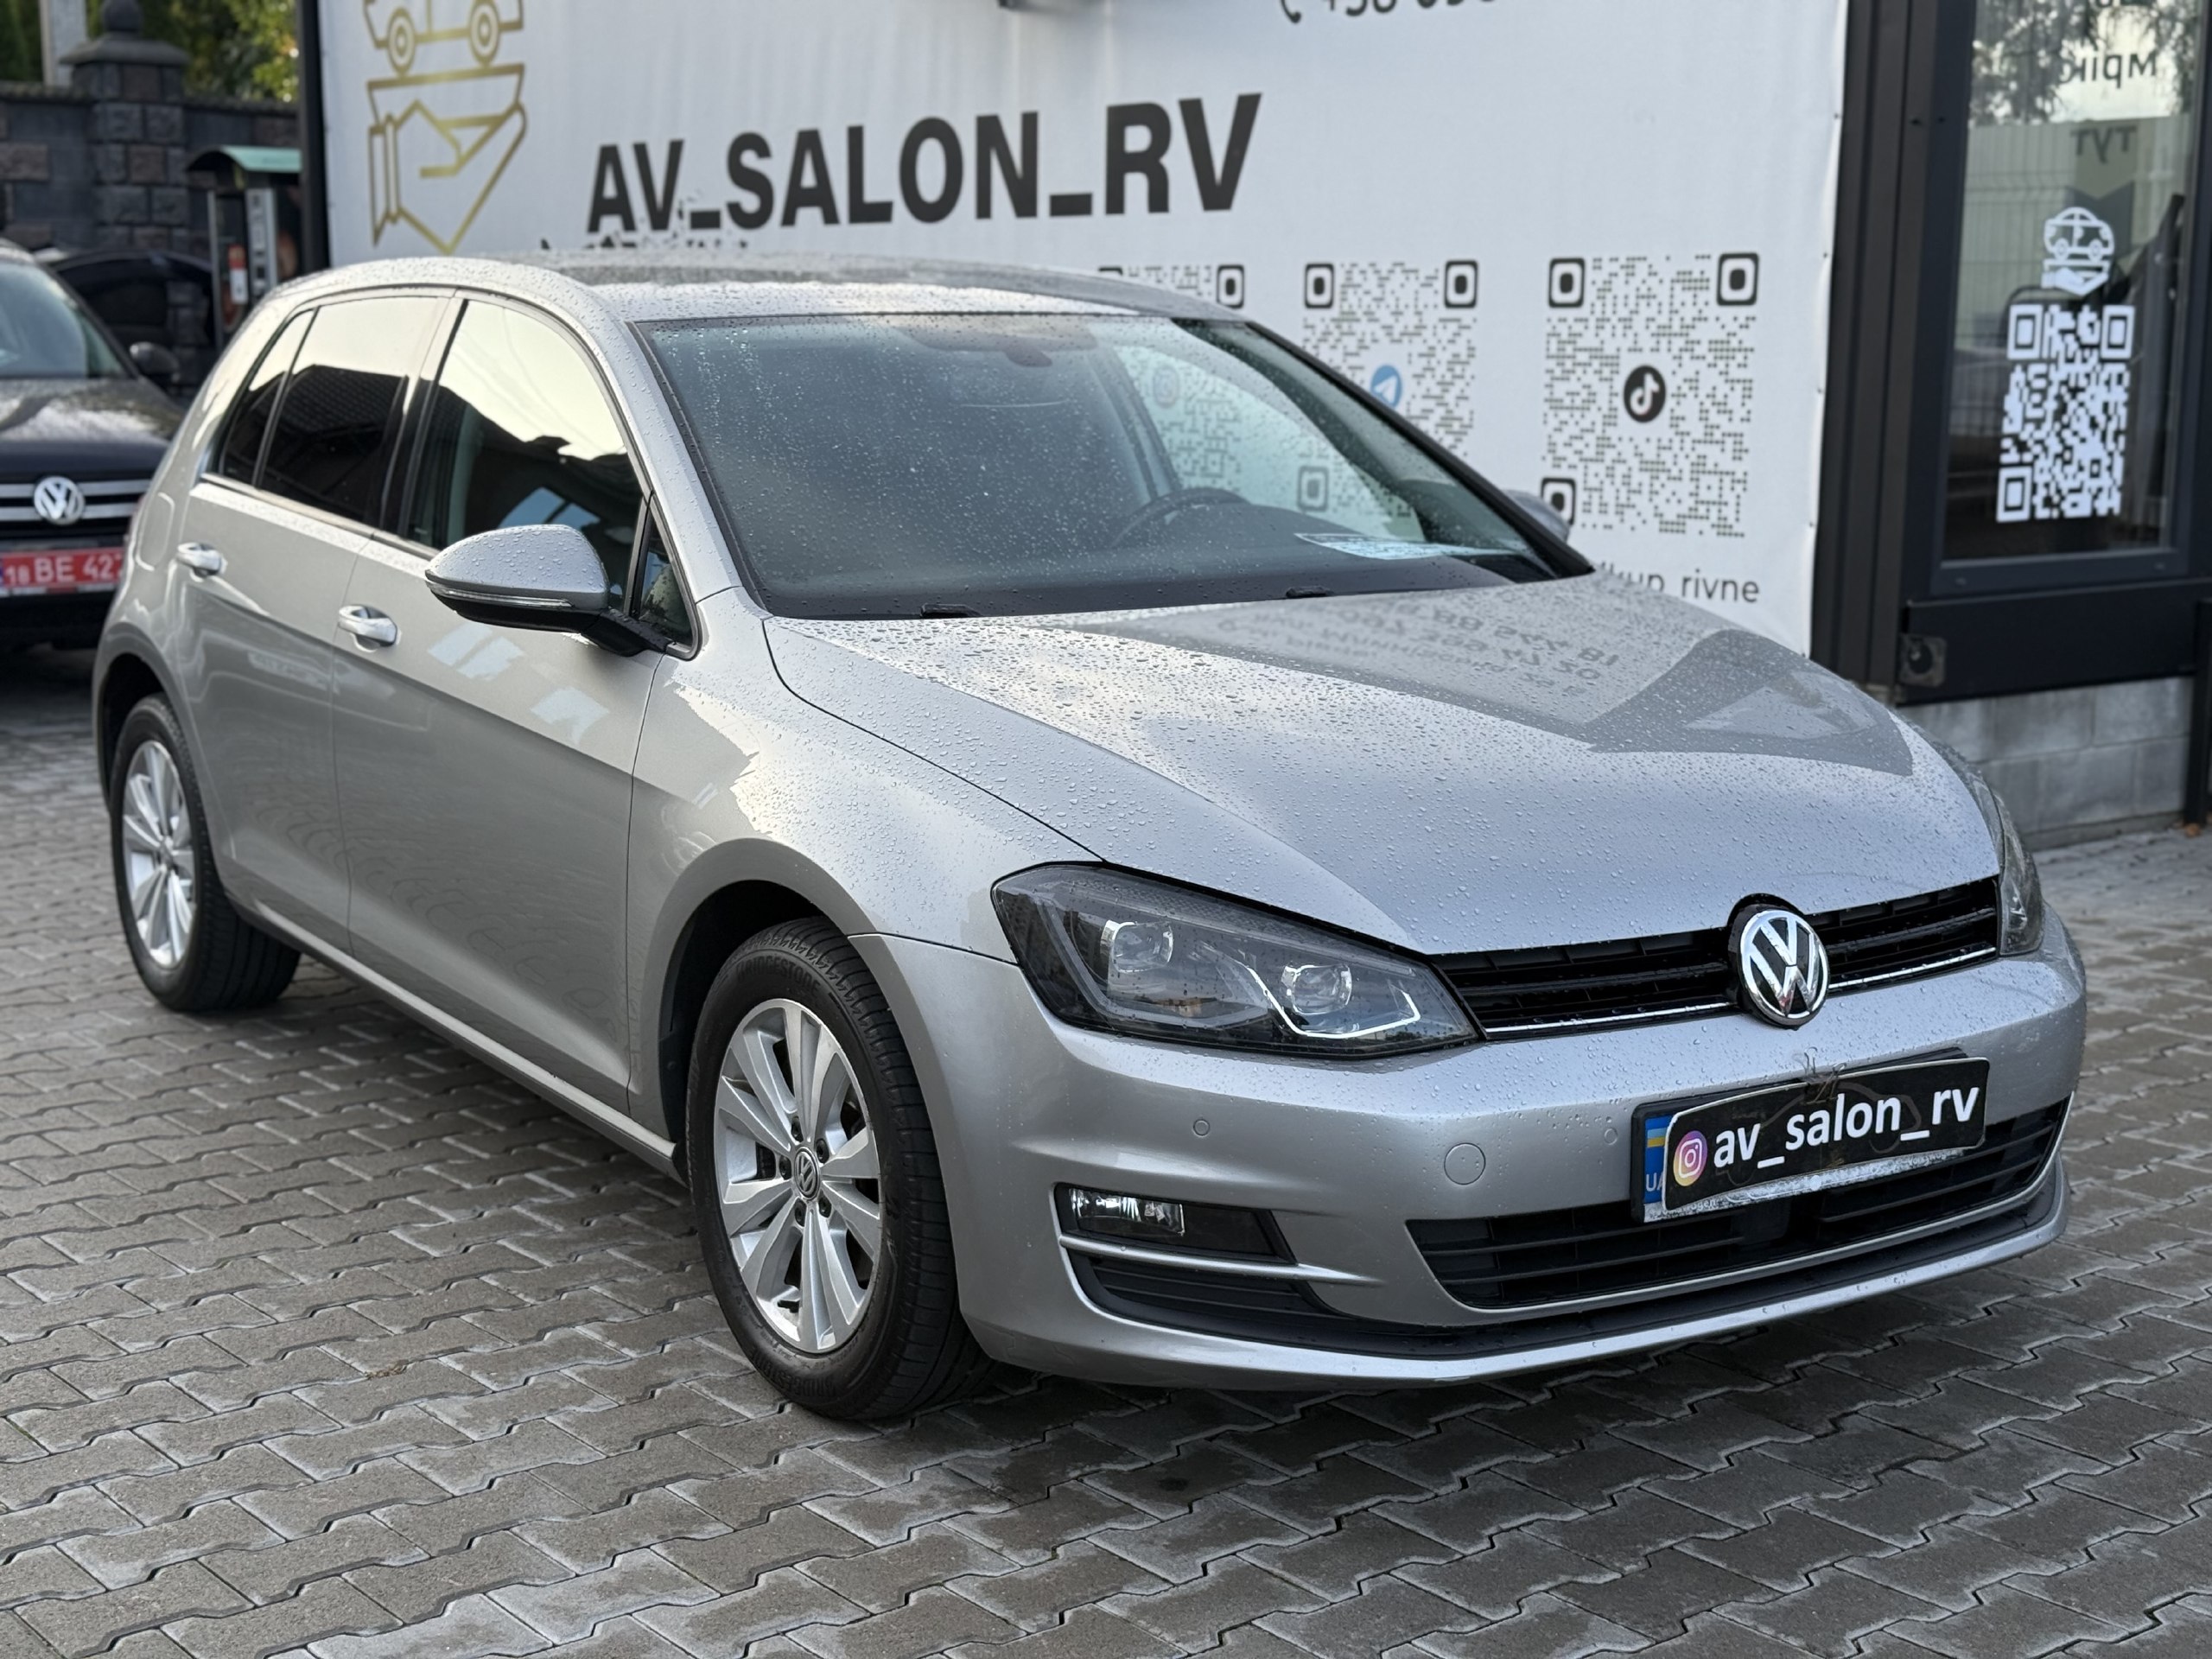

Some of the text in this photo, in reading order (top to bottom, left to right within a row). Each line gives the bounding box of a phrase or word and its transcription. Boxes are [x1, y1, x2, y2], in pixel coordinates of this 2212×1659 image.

[587, 92, 1260, 233] AV_SALON_RV
[35, 556, 75, 583] BE
[1681, 568, 1759, 603] rivne
[1713, 1087, 1979, 1169] av_salon_rv
